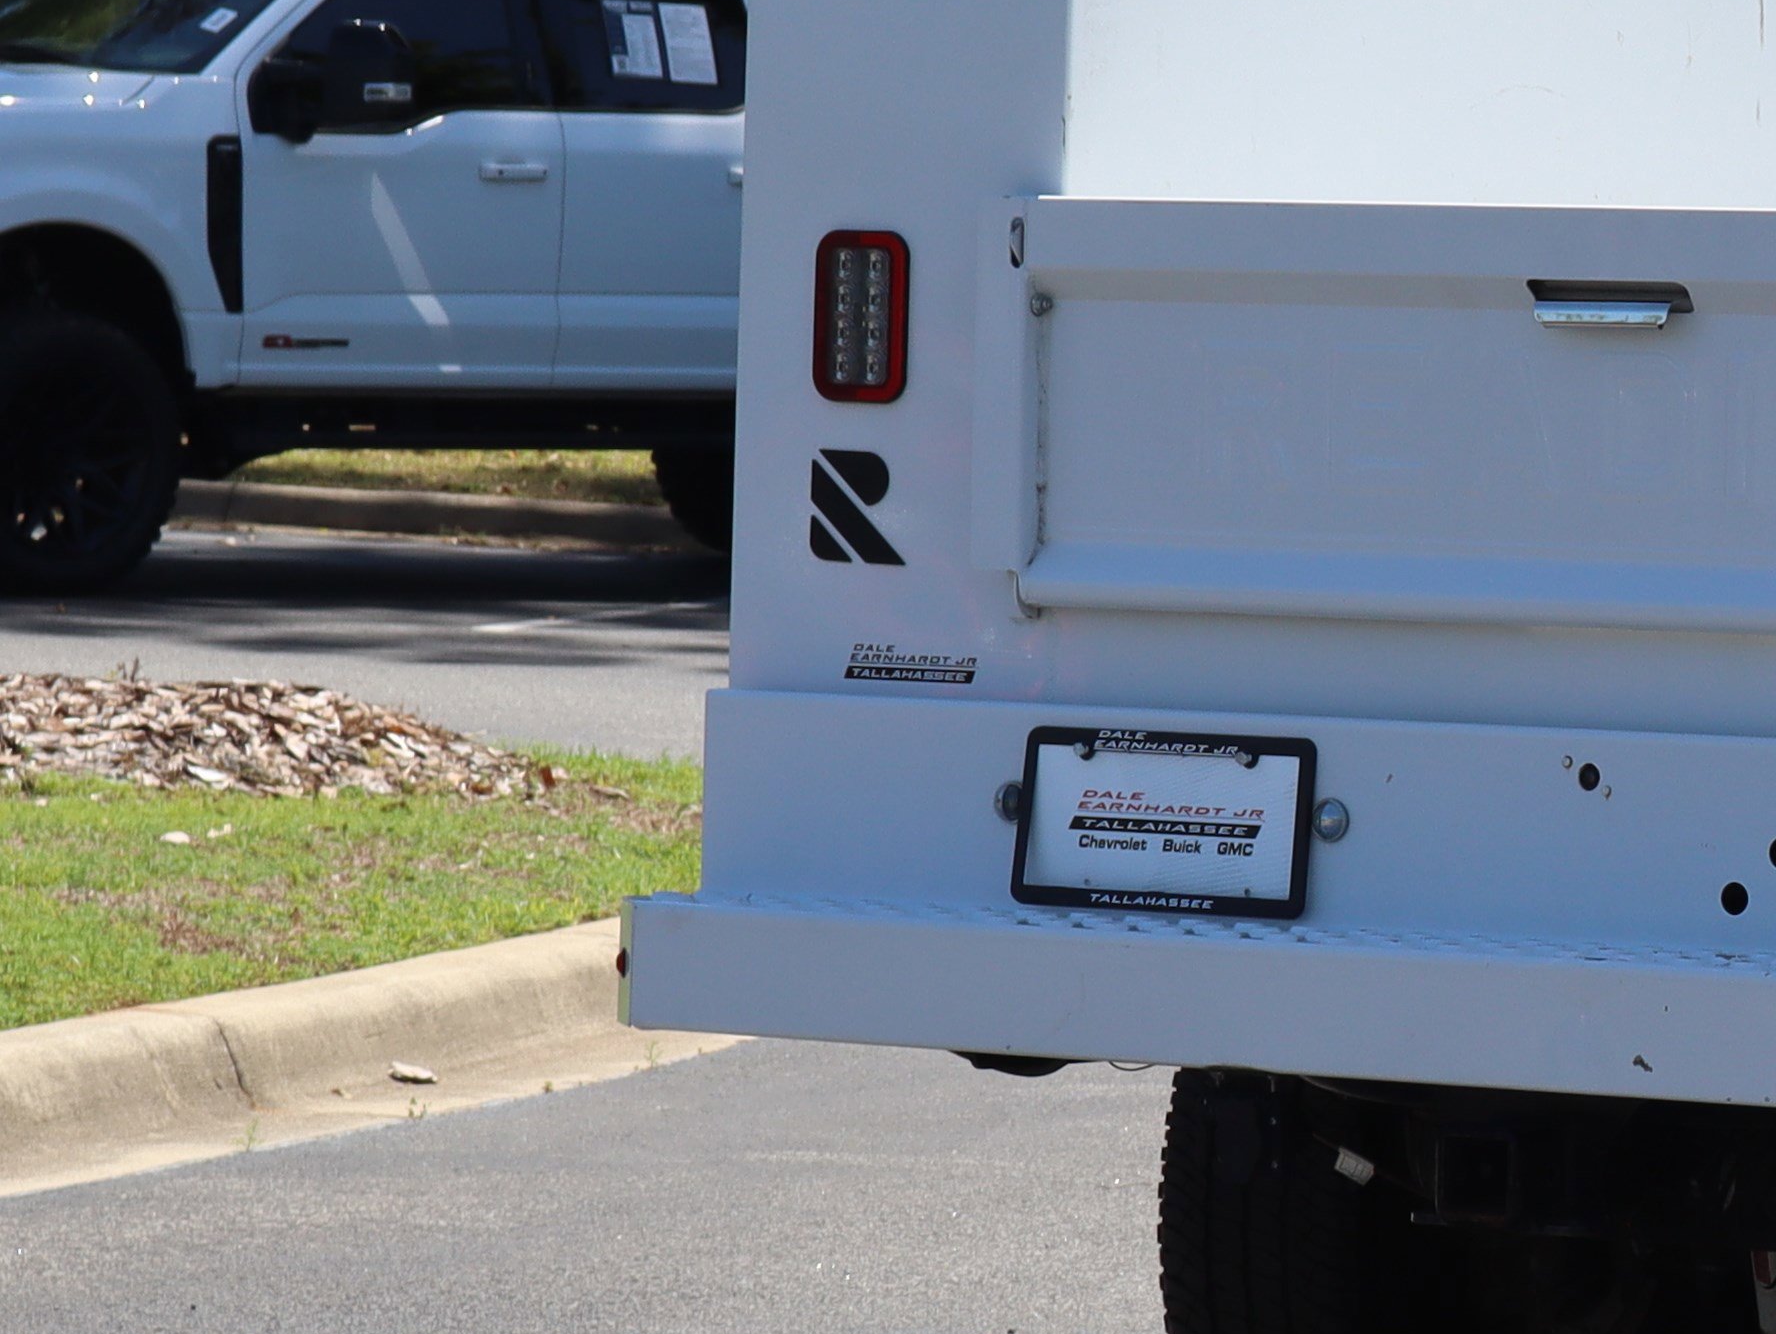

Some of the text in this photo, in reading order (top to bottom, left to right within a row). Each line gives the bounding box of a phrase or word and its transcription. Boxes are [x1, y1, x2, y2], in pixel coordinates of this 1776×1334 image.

[853, 643, 895, 653] DALE
[850, 652, 978, 666] EARNHARDT JR
[852, 668, 967, 682] TALLAHASSEE
[1098, 730, 1148, 741] DALE
[1094, 739, 1240, 755] EARNHARDT JR
[1081, 789, 1145, 801] DALE
[1077, 801, 1265, 819] EARNHARDT JR
[1082, 818, 1248, 836] TALLAHASSEE
[1078, 834, 1254, 857] Chevrolet Buick GMC
[1089, 893, 1214, 909] TALLAHASSEE
